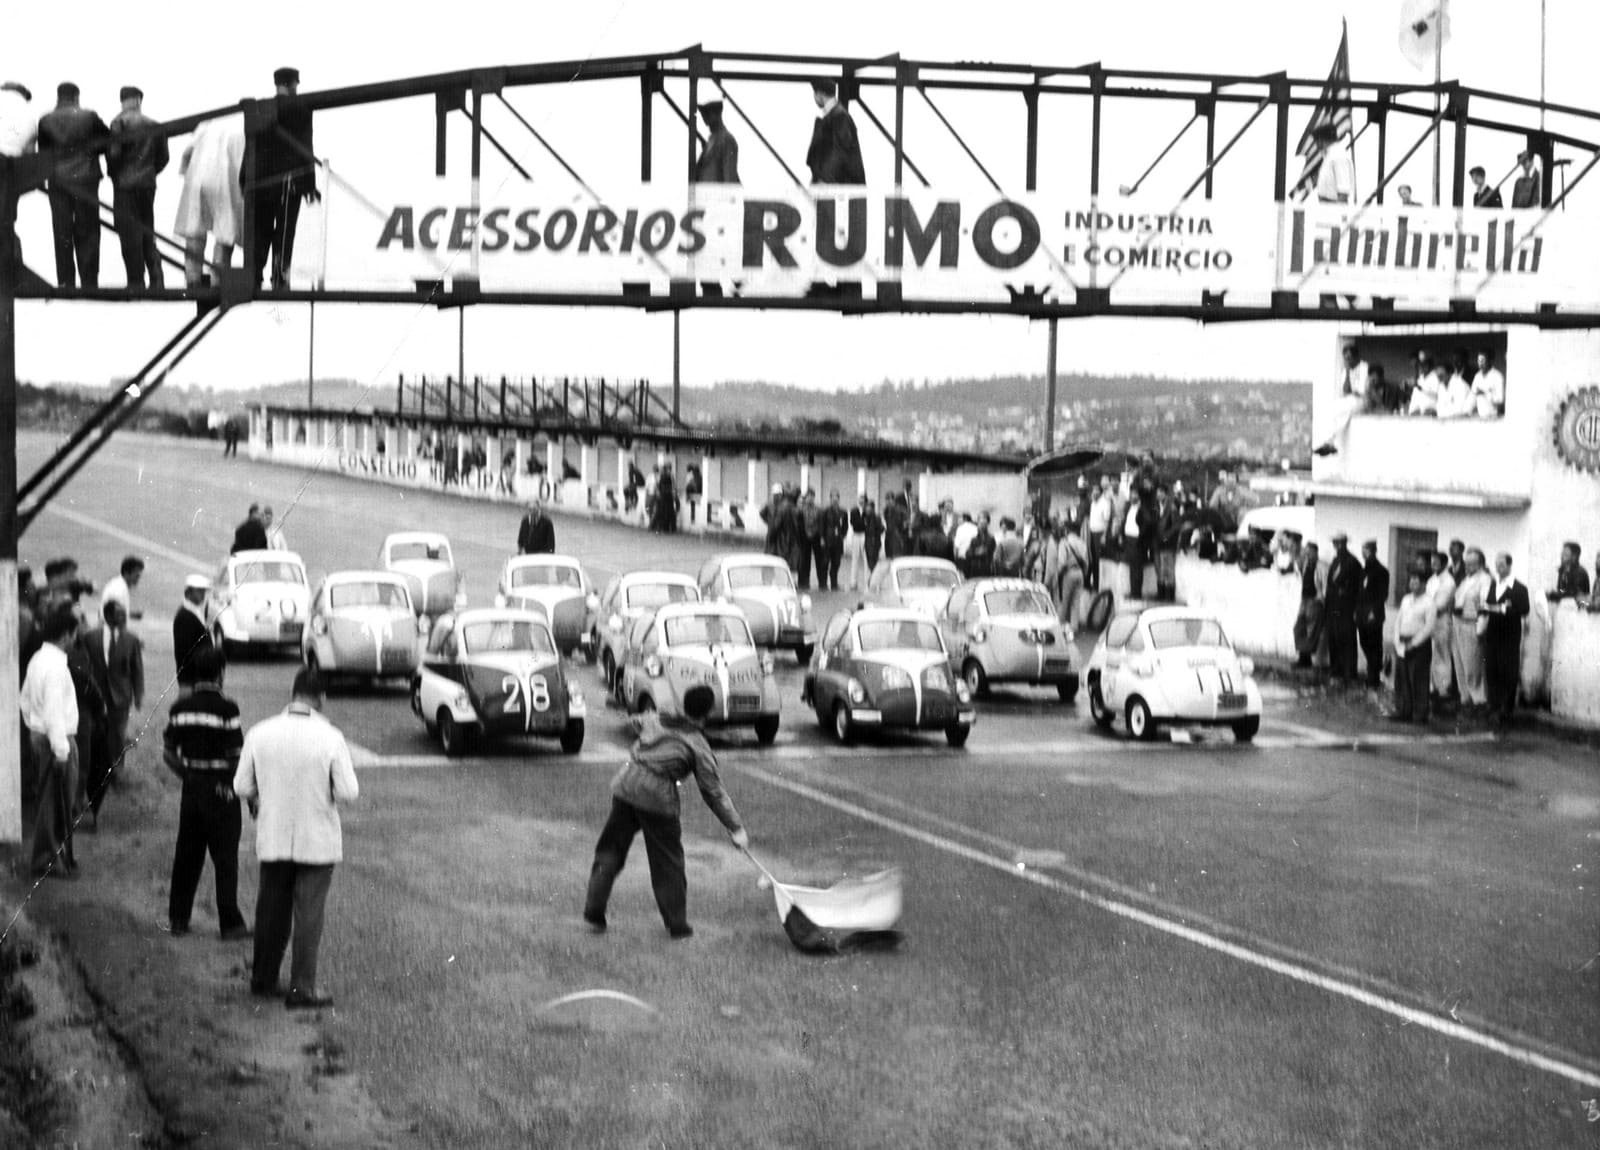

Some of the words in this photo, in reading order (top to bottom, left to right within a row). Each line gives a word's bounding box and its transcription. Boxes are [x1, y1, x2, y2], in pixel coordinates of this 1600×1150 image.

[376, 206, 706, 253] ACESSORIOS
[742, 198, 1041, 269] RUMO
[1064, 211, 1213, 235] INDUSTRIA
[1084, 245, 1232, 272] COMERCIO
[501, 673, 550, 713] 28
